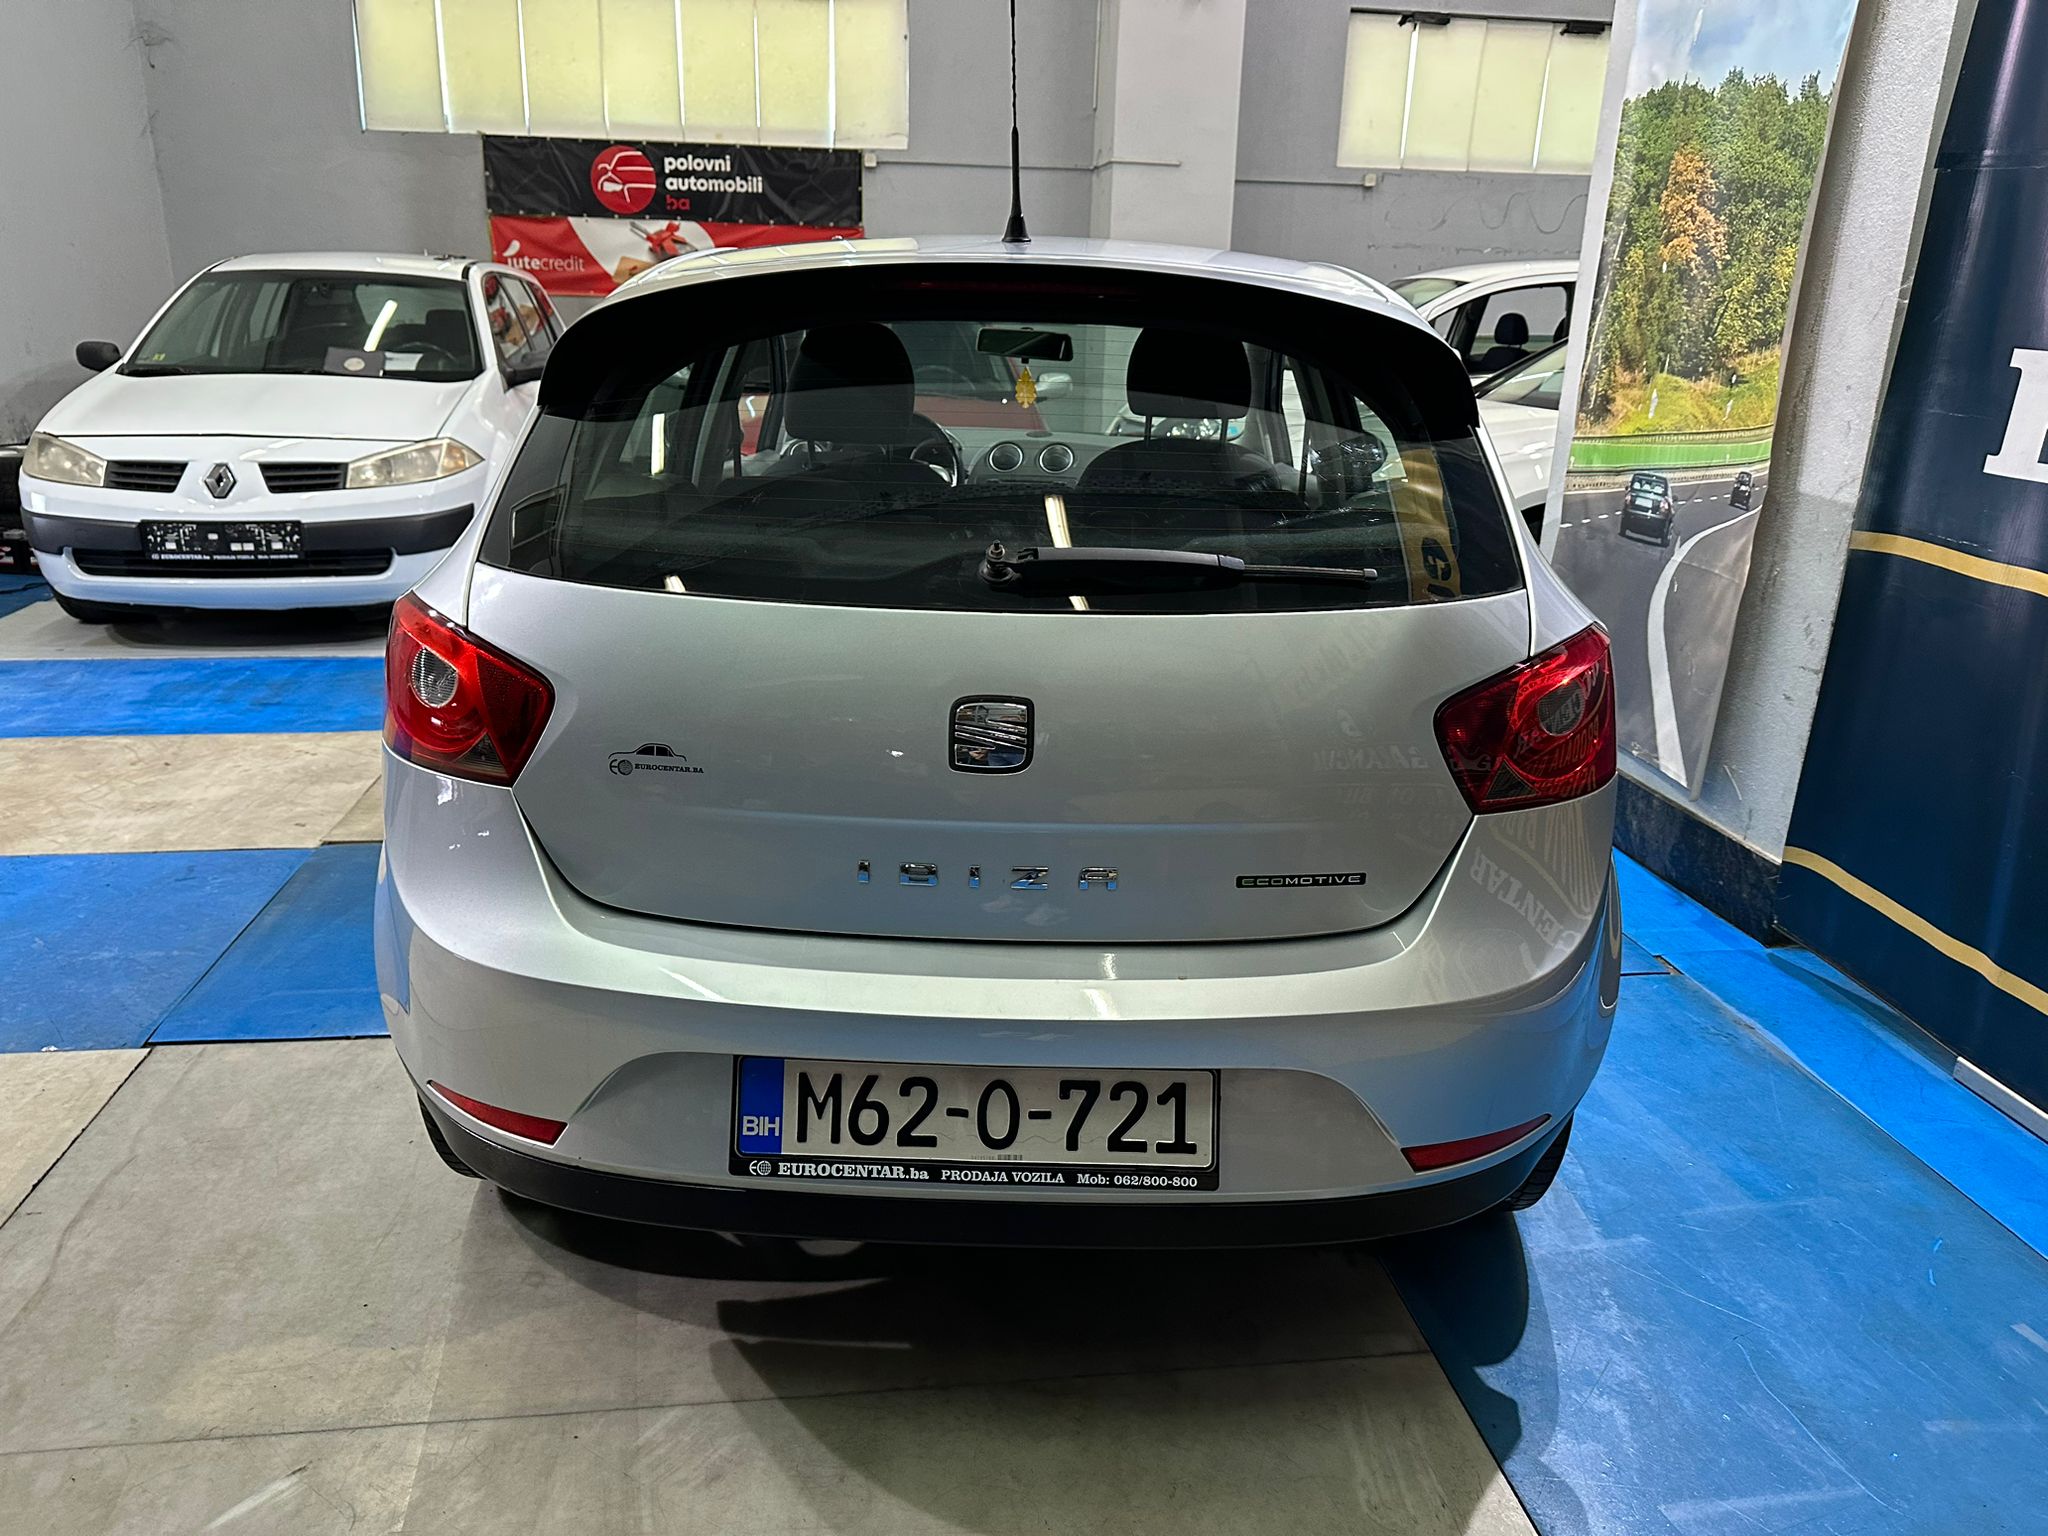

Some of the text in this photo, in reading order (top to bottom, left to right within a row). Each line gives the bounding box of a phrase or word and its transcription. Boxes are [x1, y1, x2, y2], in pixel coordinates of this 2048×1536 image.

[663, 154, 731, 174] polovni
[664, 175, 763, 194] automobili
[634, 763, 704, 774] EUROCENTAR.BA
[857, 859, 1118, 890] IBIZA
[1241, 875, 1361, 886] ECOMOTIVE
[742, 1115, 780, 1137] BIH
[777, 1162, 930, 1180] EUROCENTAR.ba
[940, 1169, 1009, 1182] PRODAJA
[1011, 1171, 1066, 1184] VOZILA
[1076, 1173, 1110, 1185] Mob:
[1113, 1175, 1198, 1188] 062/800-800
